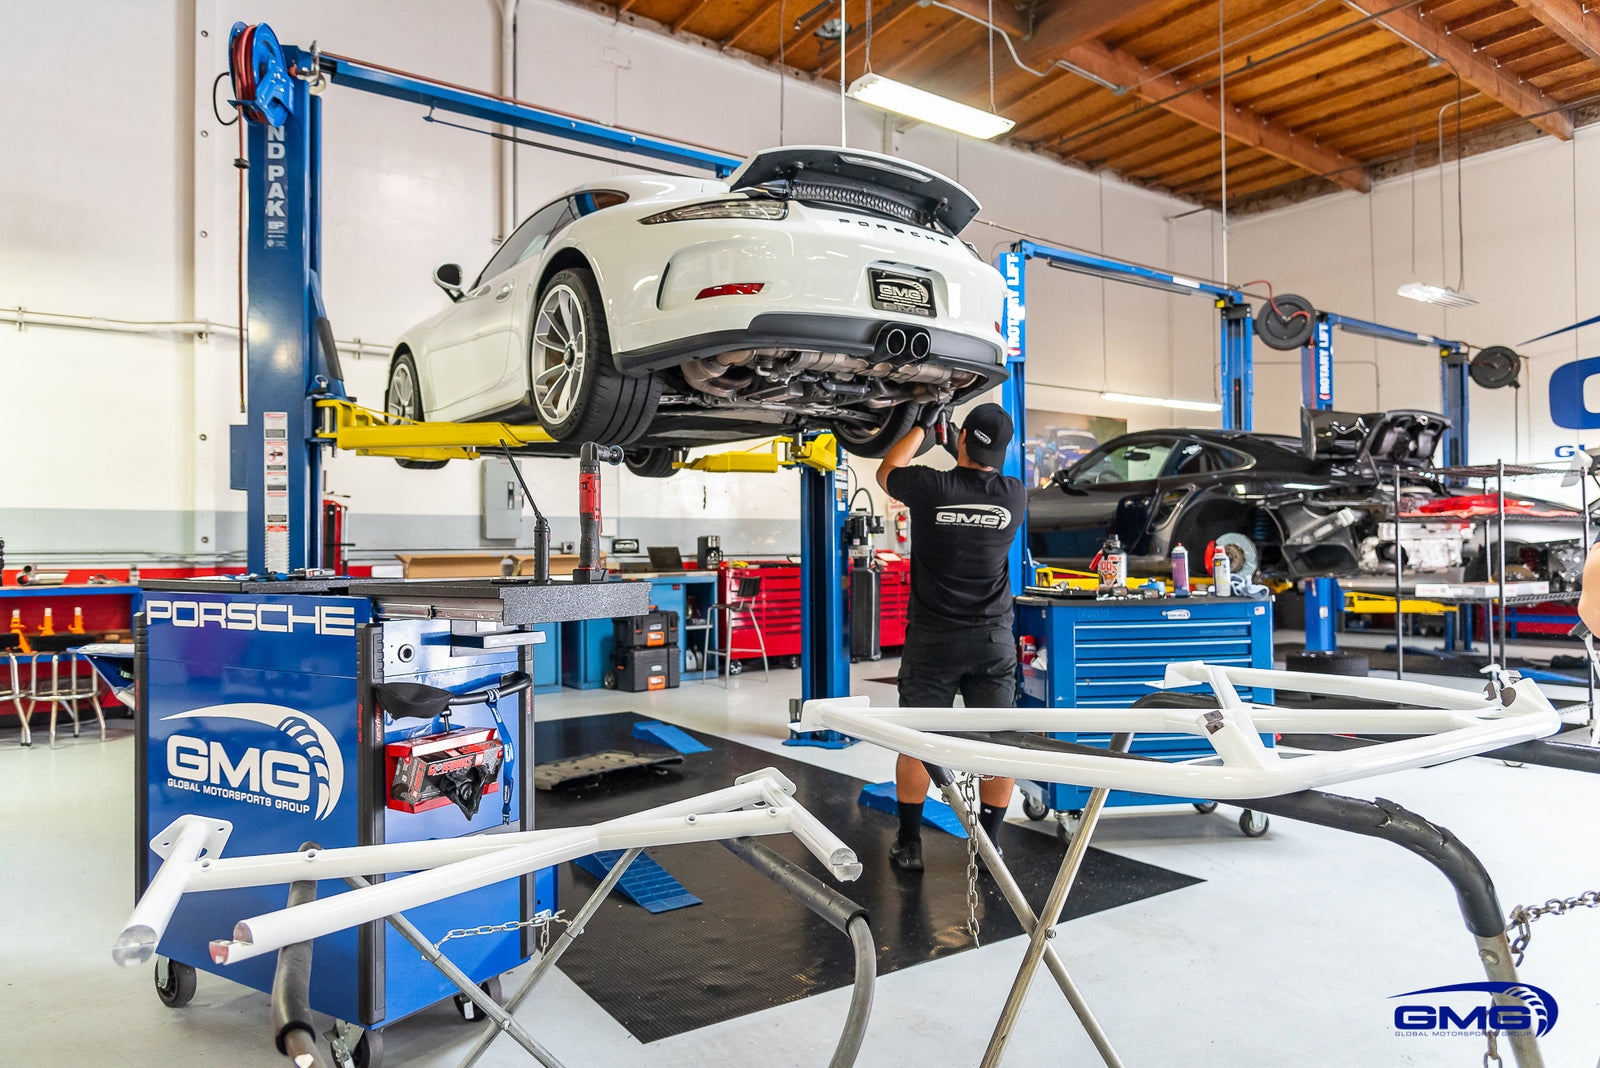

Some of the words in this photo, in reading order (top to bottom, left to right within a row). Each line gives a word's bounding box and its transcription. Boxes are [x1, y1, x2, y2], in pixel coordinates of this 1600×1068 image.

[267, 125, 286, 159] ND
[267, 165, 286, 217] PAK
[838, 218, 950, 246] PORSCHE
[1006, 253, 1020, 286] LIFT
[879, 284, 922, 300] GMG
[1007, 288, 1020, 348] ROTRY
[1318, 323, 1329, 347] LIFT
[1319, 349, 1330, 394] ROTARY
[936, 511, 1001, 526] GMG
[146, 600, 355, 637] PORSCHE
[166, 734, 311, 801] GMG
[167, 778, 201, 793] GLOBAL
[202, 785, 272, 807] MOTORSPORTS
[274, 799, 310, 814] GROUP
